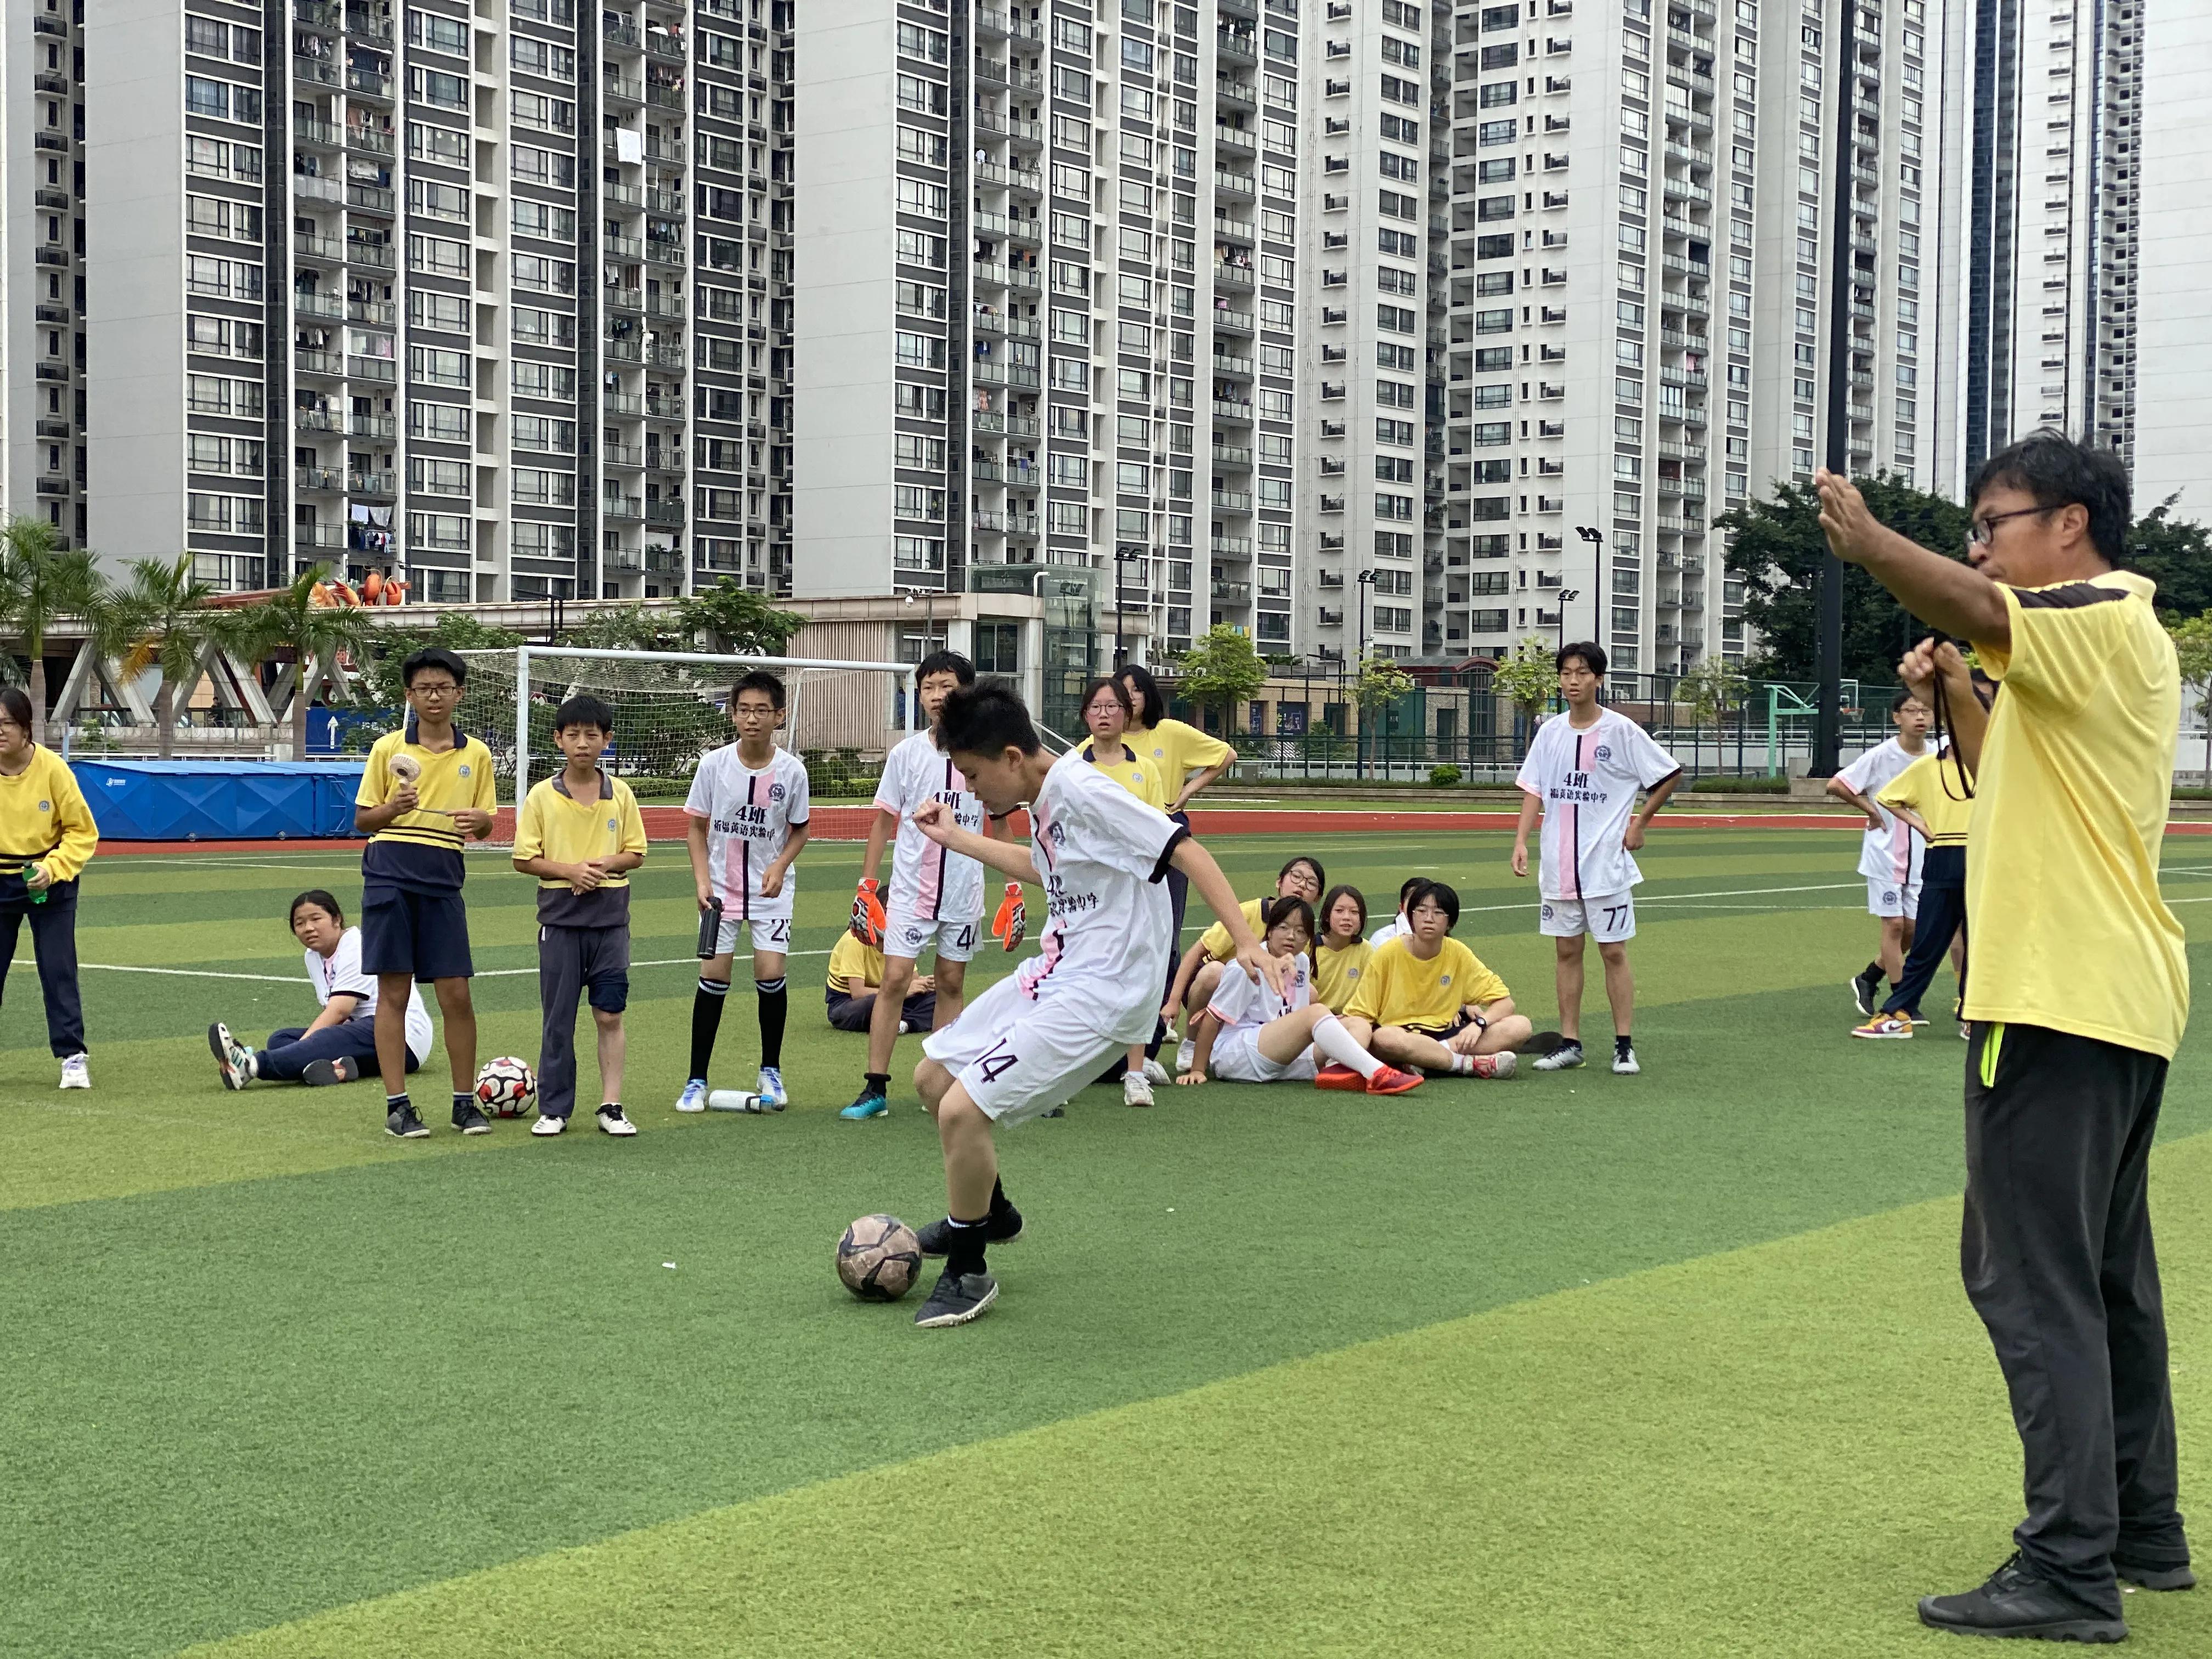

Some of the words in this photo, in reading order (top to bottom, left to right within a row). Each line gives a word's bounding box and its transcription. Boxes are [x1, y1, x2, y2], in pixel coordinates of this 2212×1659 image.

[1562, 772, 1588, 788] 4班
[735, 805, 768, 825] 4班
[1602, 904, 1628, 932] 77
[973, 1037, 1019, 1084] 14
